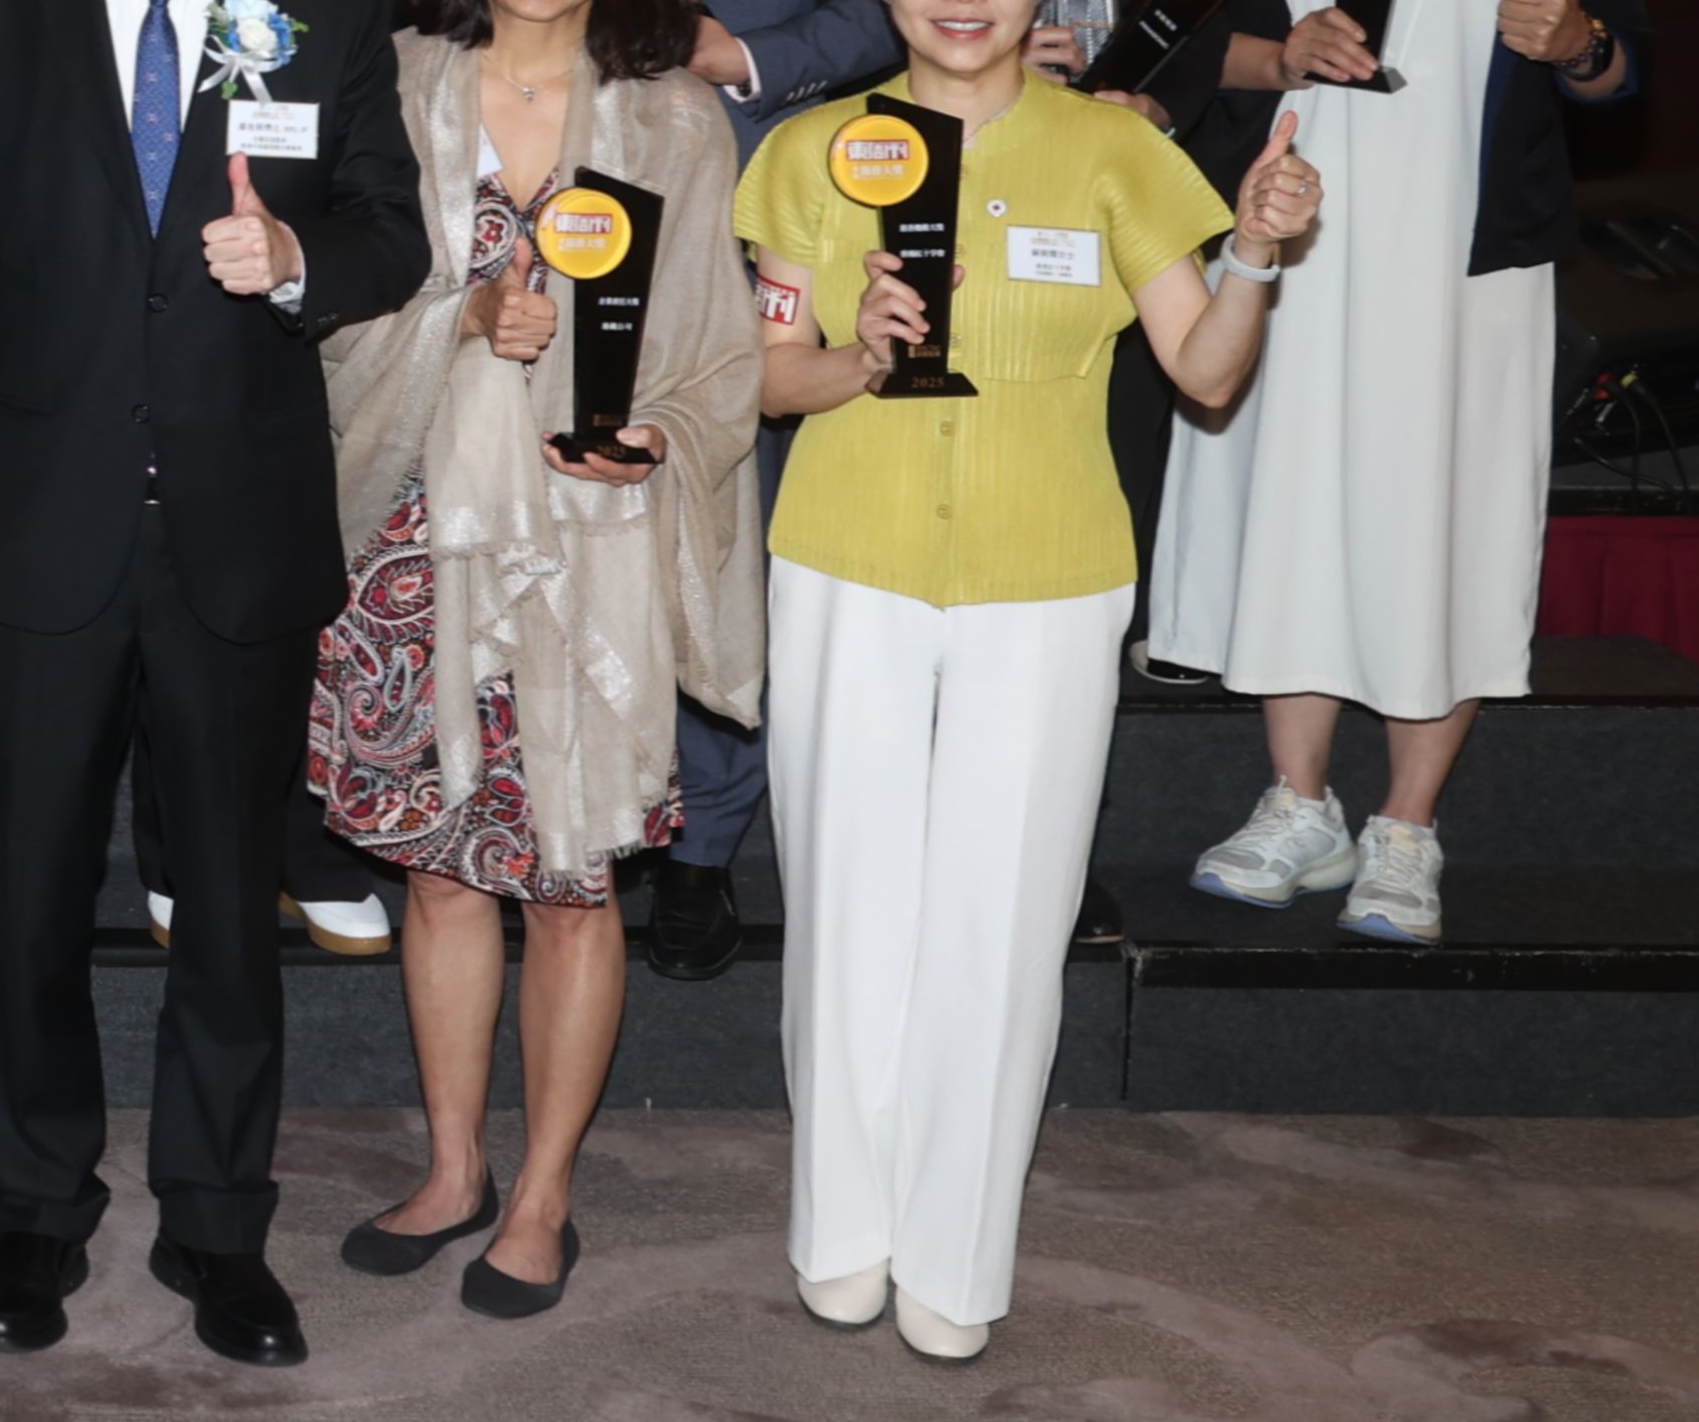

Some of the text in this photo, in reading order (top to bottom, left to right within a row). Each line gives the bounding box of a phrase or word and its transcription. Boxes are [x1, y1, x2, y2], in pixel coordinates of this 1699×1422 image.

[847, 140, 909, 160] 東周刊
[555, 214, 611, 233] 東周刊
